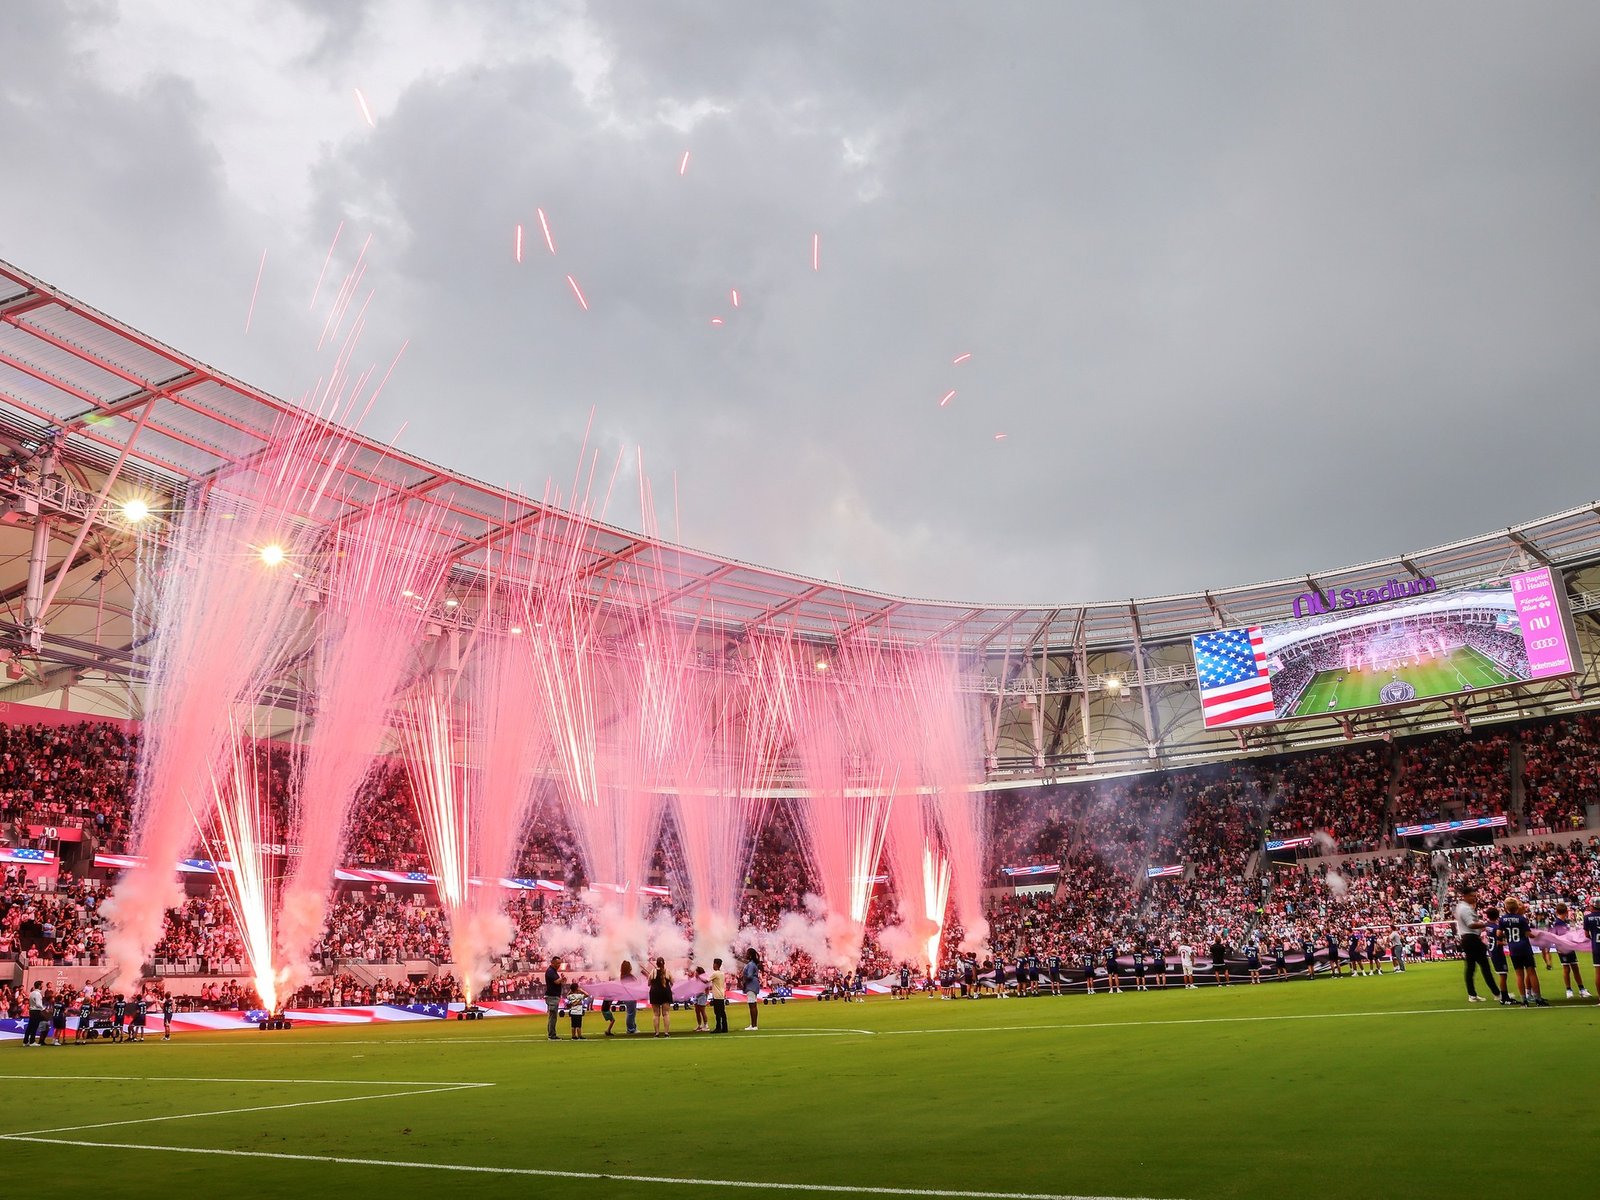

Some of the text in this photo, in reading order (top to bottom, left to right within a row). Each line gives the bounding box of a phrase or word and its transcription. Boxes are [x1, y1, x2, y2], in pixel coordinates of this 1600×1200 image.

[1525, 573, 1548, 584] Baptist
[1527, 580, 1550, 590] Health
[1341, 576, 1437, 609] Stadium
[1446, 728, 1463, 738] 208
[1506, 927, 1520, 943] 18
